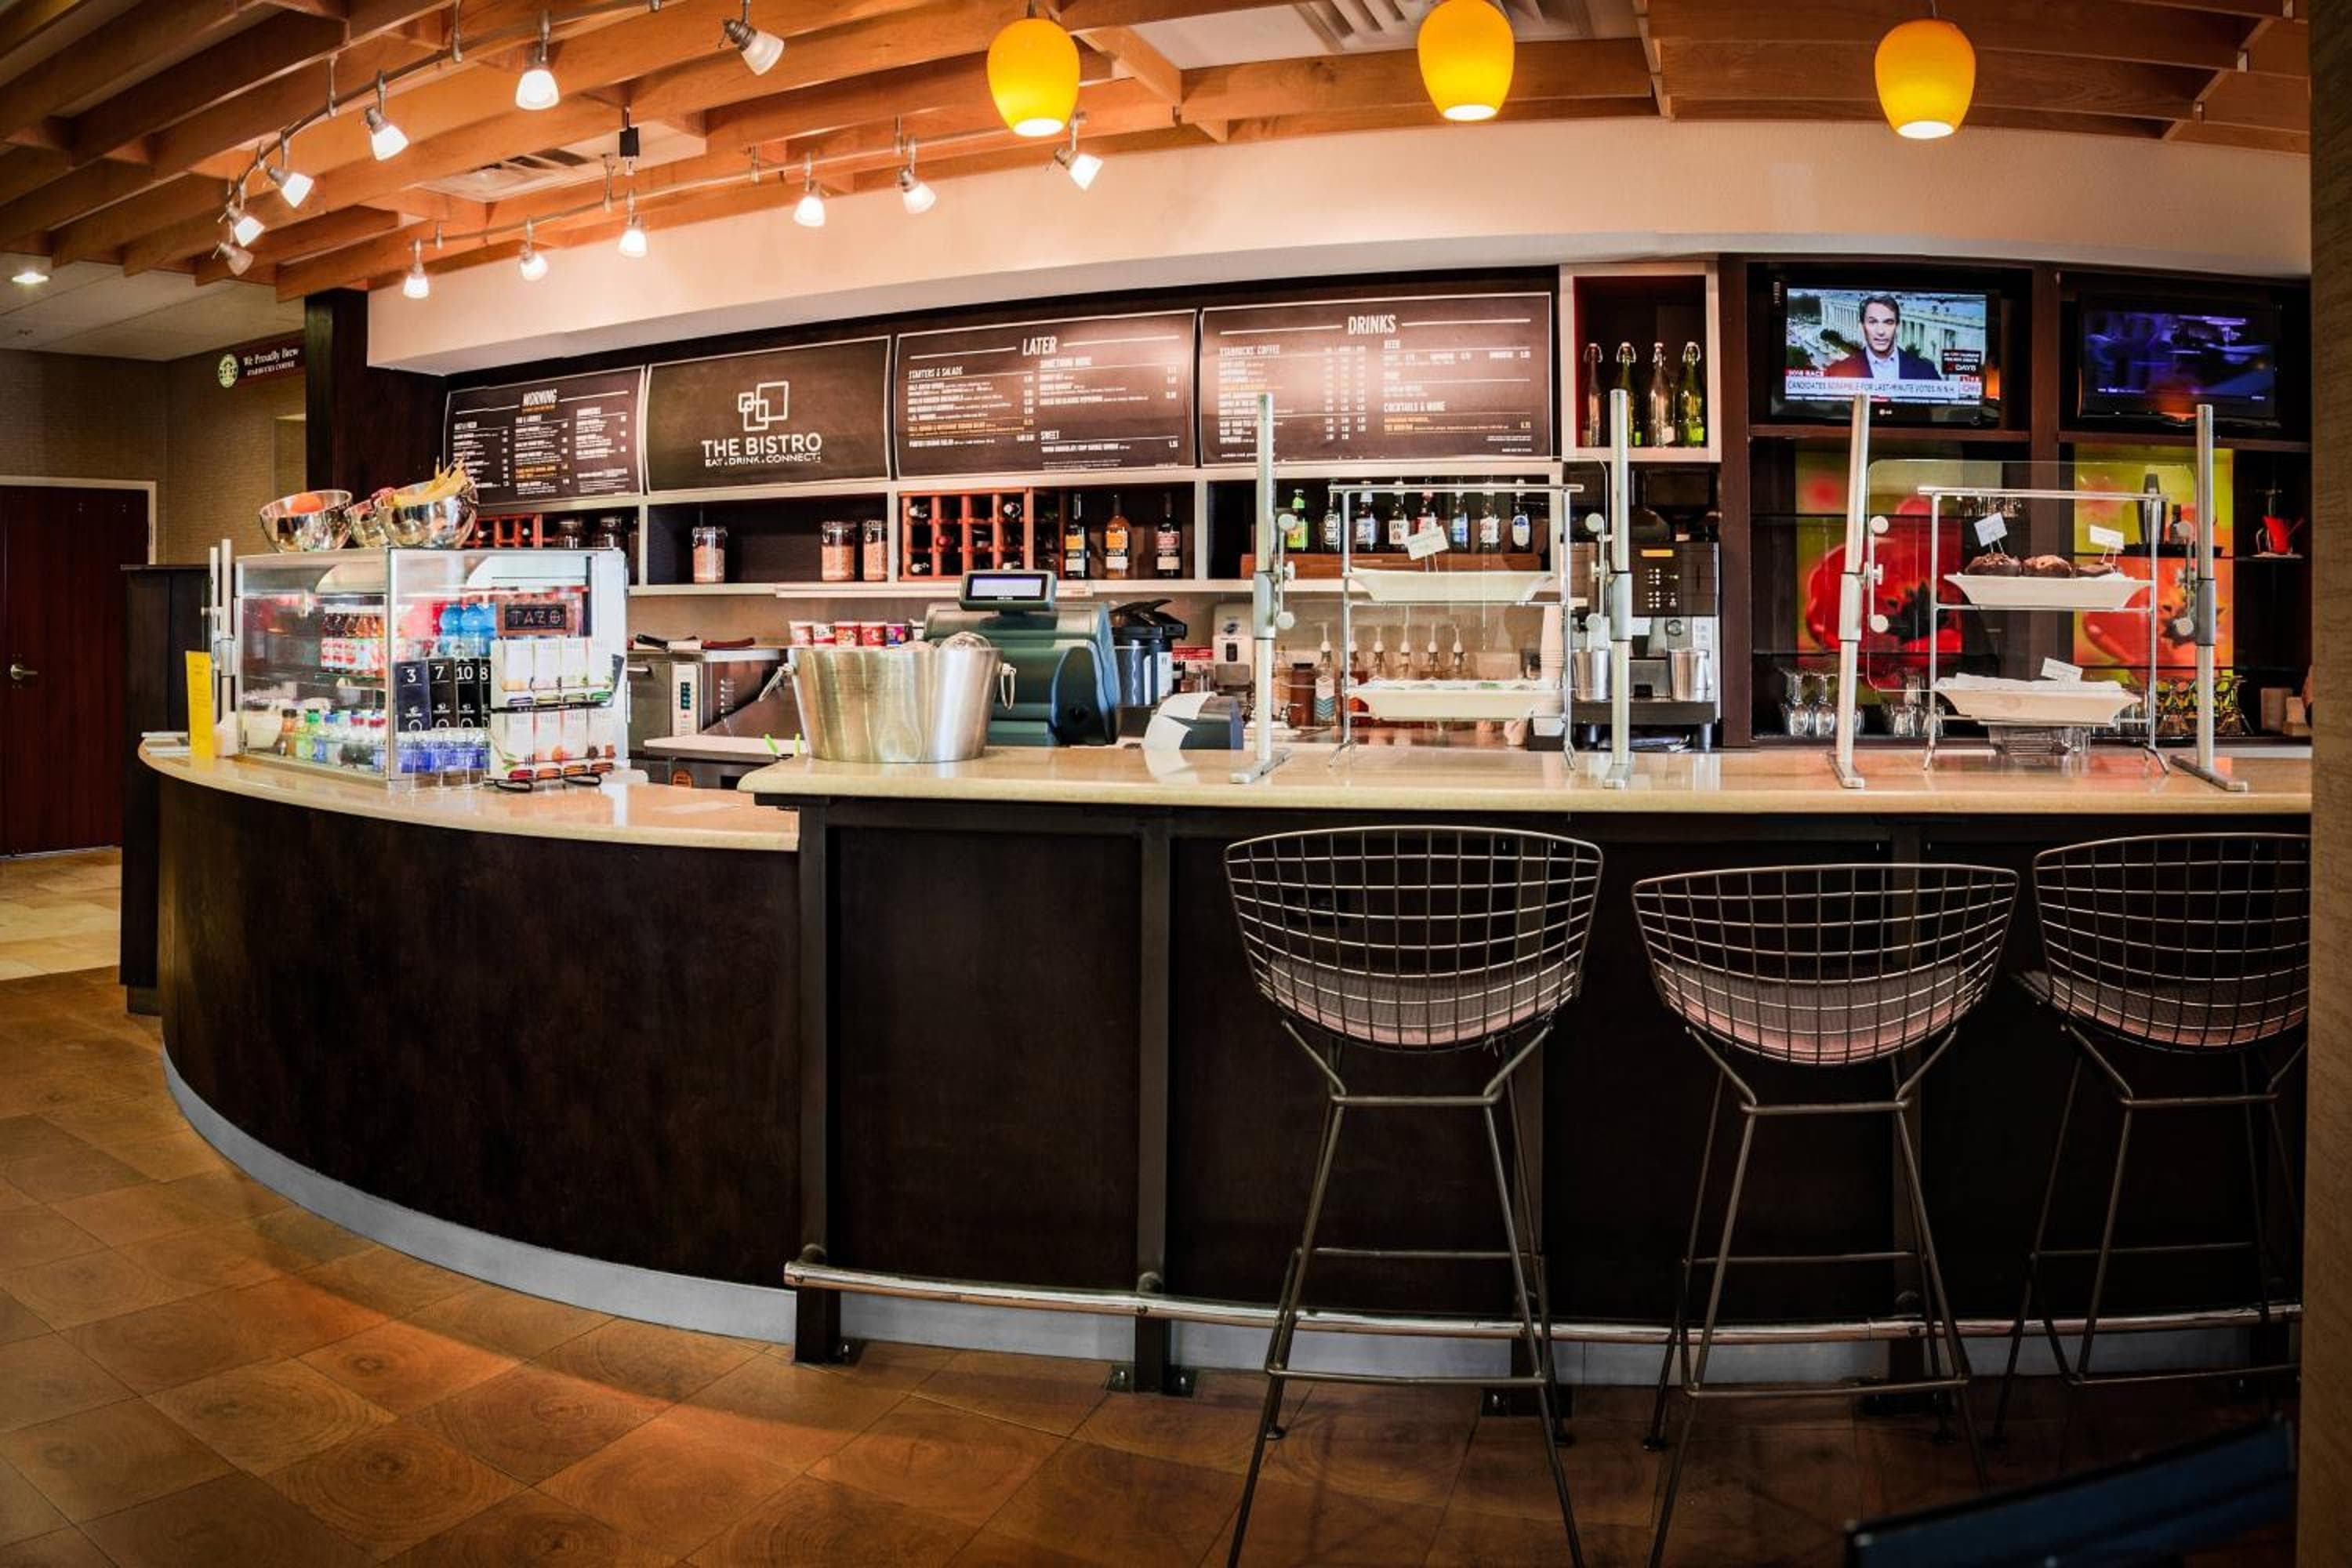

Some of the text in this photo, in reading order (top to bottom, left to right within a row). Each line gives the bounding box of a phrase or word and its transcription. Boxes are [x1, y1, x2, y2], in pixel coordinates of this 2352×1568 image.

[1348, 314, 1396, 335] DRINKS
[1022, 336, 1058, 356] LATER
[1787, 380, 1826, 390] CANDIDATES
[701, 432, 822, 459] THE BISTRO
[508, 609, 561, 626] TAZO
[406, 669, 416, 684] 3
[434, 666, 445, 681] 7
[456, 666, 474, 681] 10
[479, 666, 488, 681] 8
